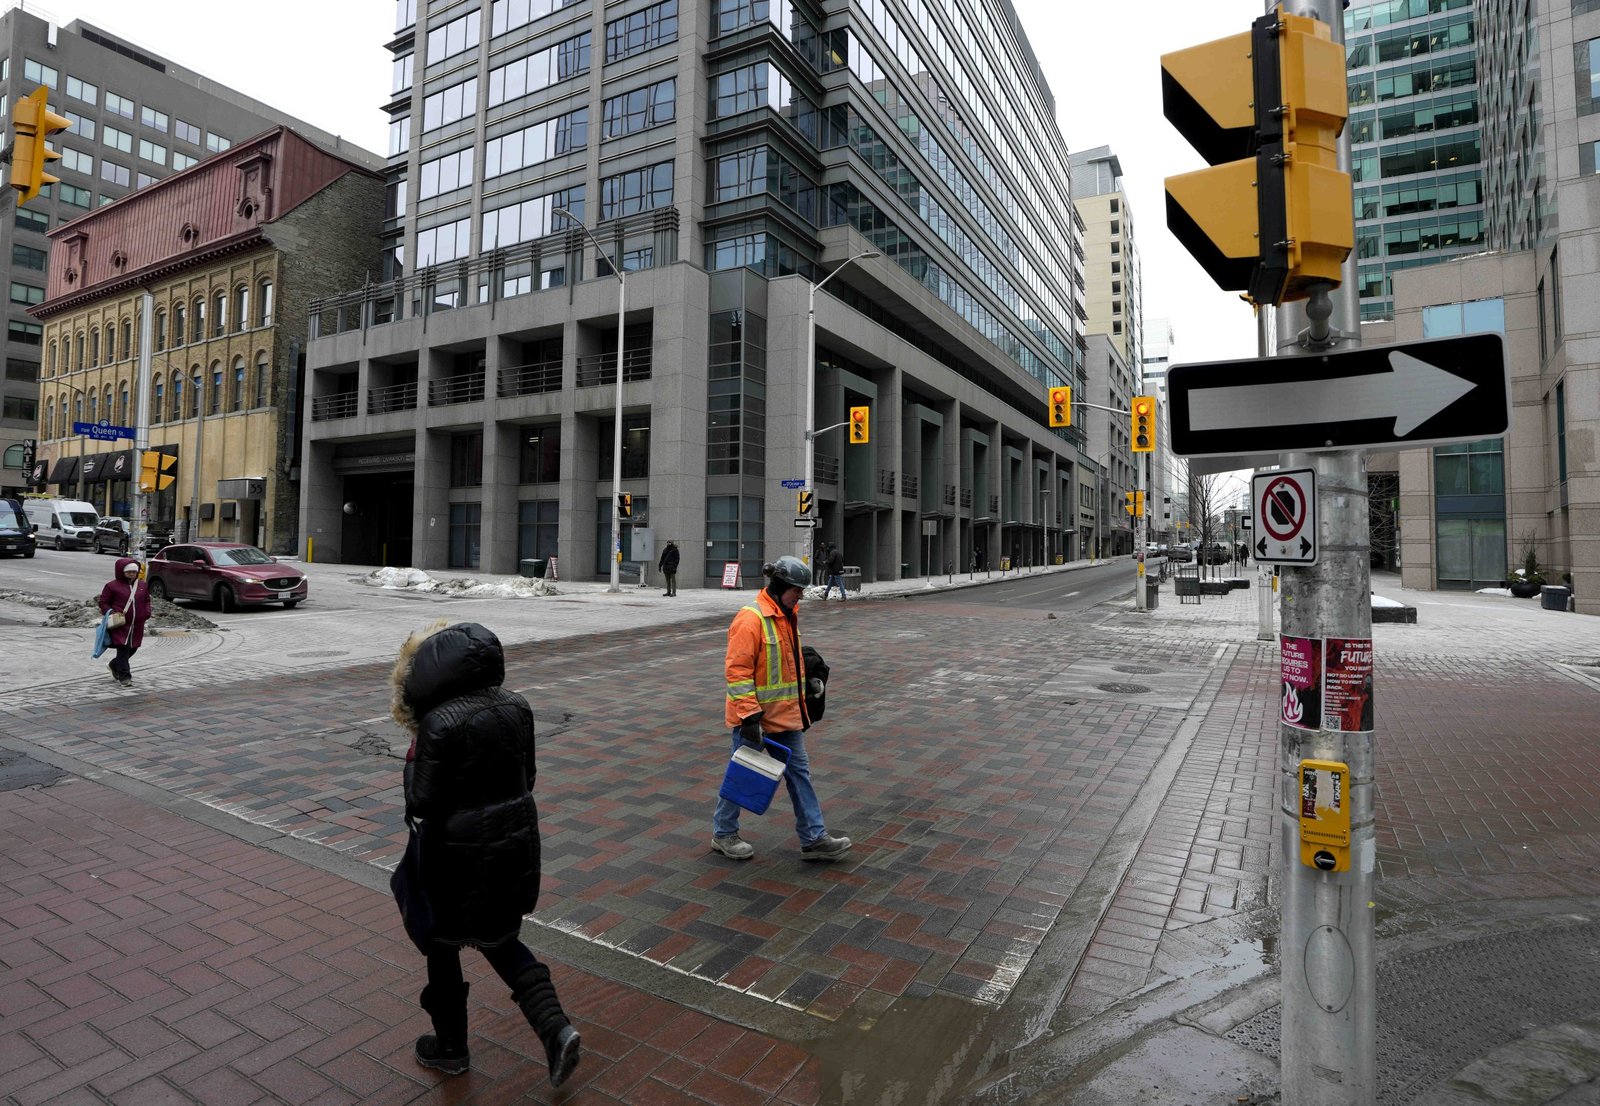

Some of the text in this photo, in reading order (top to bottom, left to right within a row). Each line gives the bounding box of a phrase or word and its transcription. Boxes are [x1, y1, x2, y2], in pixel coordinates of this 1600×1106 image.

[92, 425, 117, 436] Queen
[250, 484, 263, 494] 35
[1289, 674, 1309, 683] NOW.
